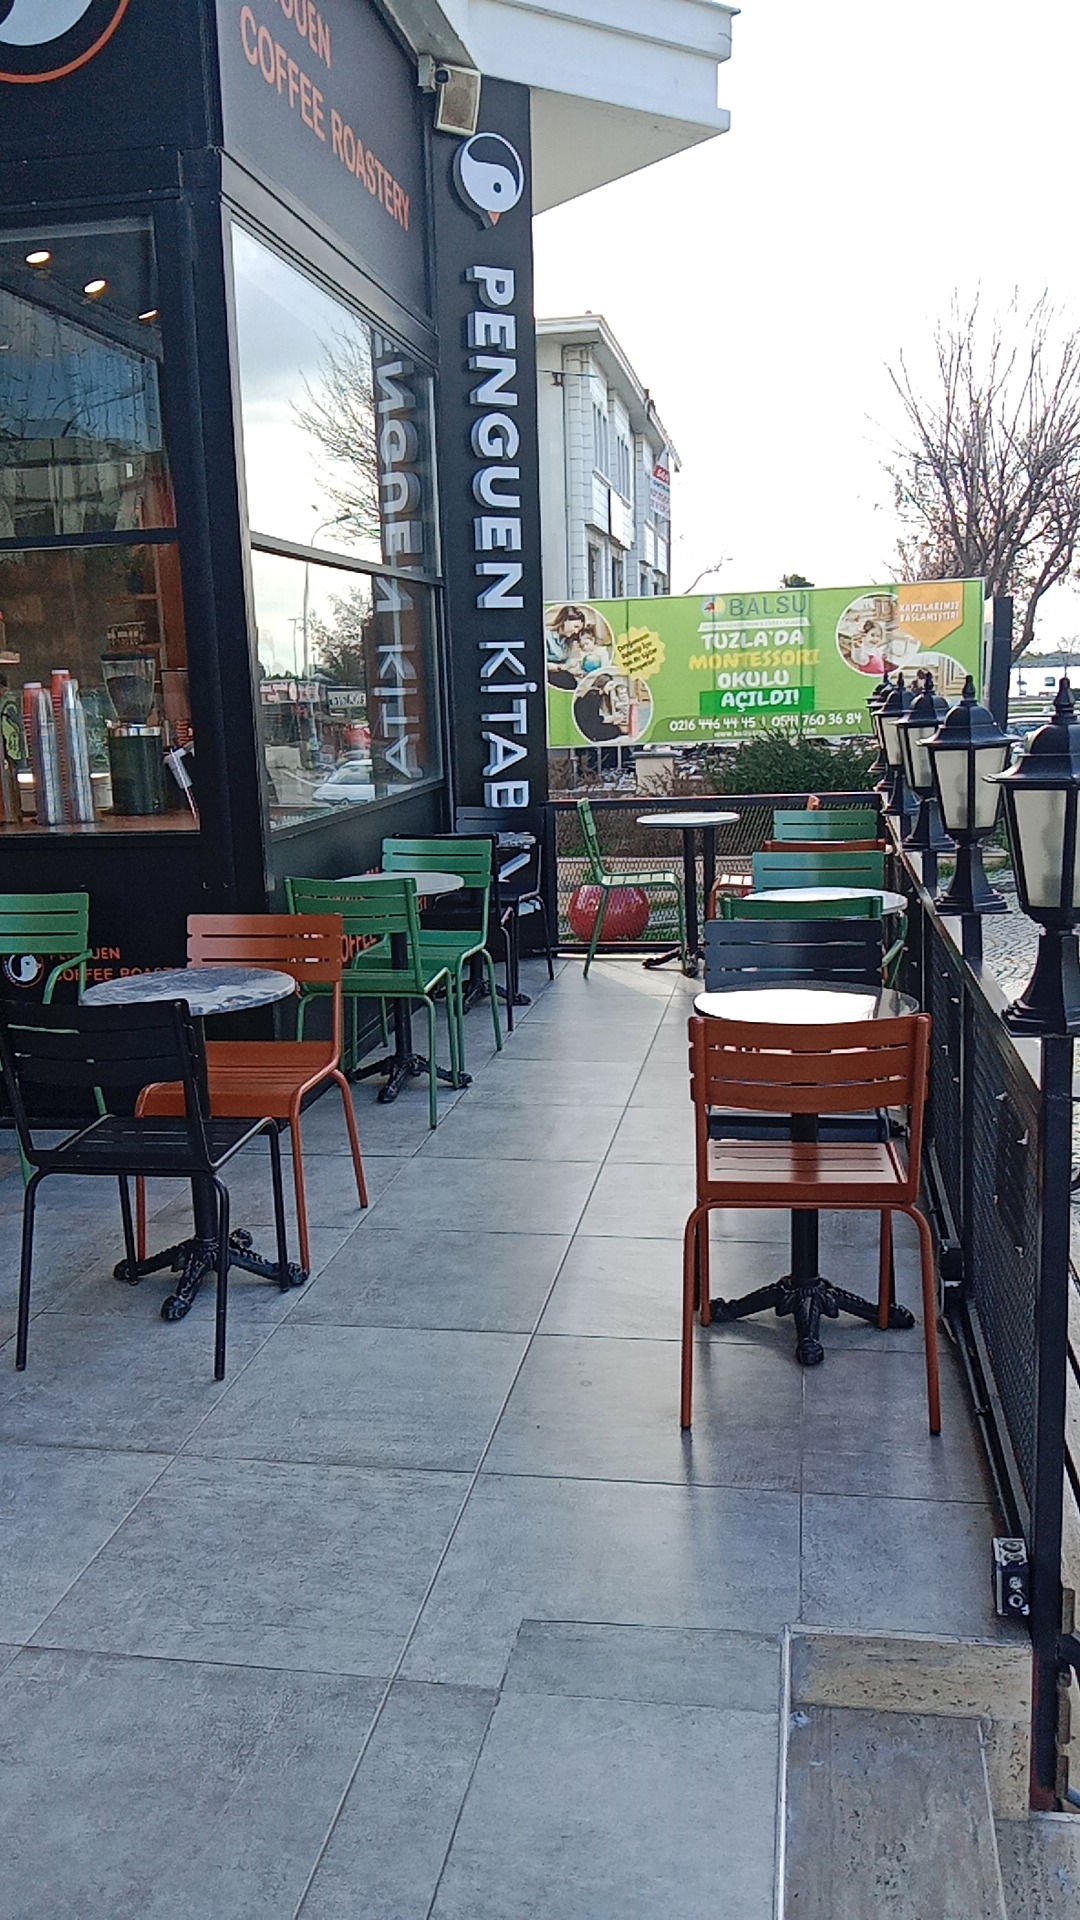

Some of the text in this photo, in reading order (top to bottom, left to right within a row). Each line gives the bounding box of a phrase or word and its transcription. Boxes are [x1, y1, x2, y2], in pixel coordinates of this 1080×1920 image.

[240, 5, 411, 231] COFFEE ROASTERY
[468, 265, 524, 609] PENGUEN
[729, 595, 807, 616] BALSU
[701, 629, 804, 650] TUZLA'DA
[717, 669, 789, 689] OKULU
[721, 689, 799, 712] AÇILDI!
[669, 719, 696, 731] 0216
[698, 718, 720, 730] 446
[722, 717, 739, 729] 44
[741, 716, 756, 728] 45
[801, 714, 826, 726] 760
[827, 713, 843, 725] 36
[845, 712, 862, 724] 84
